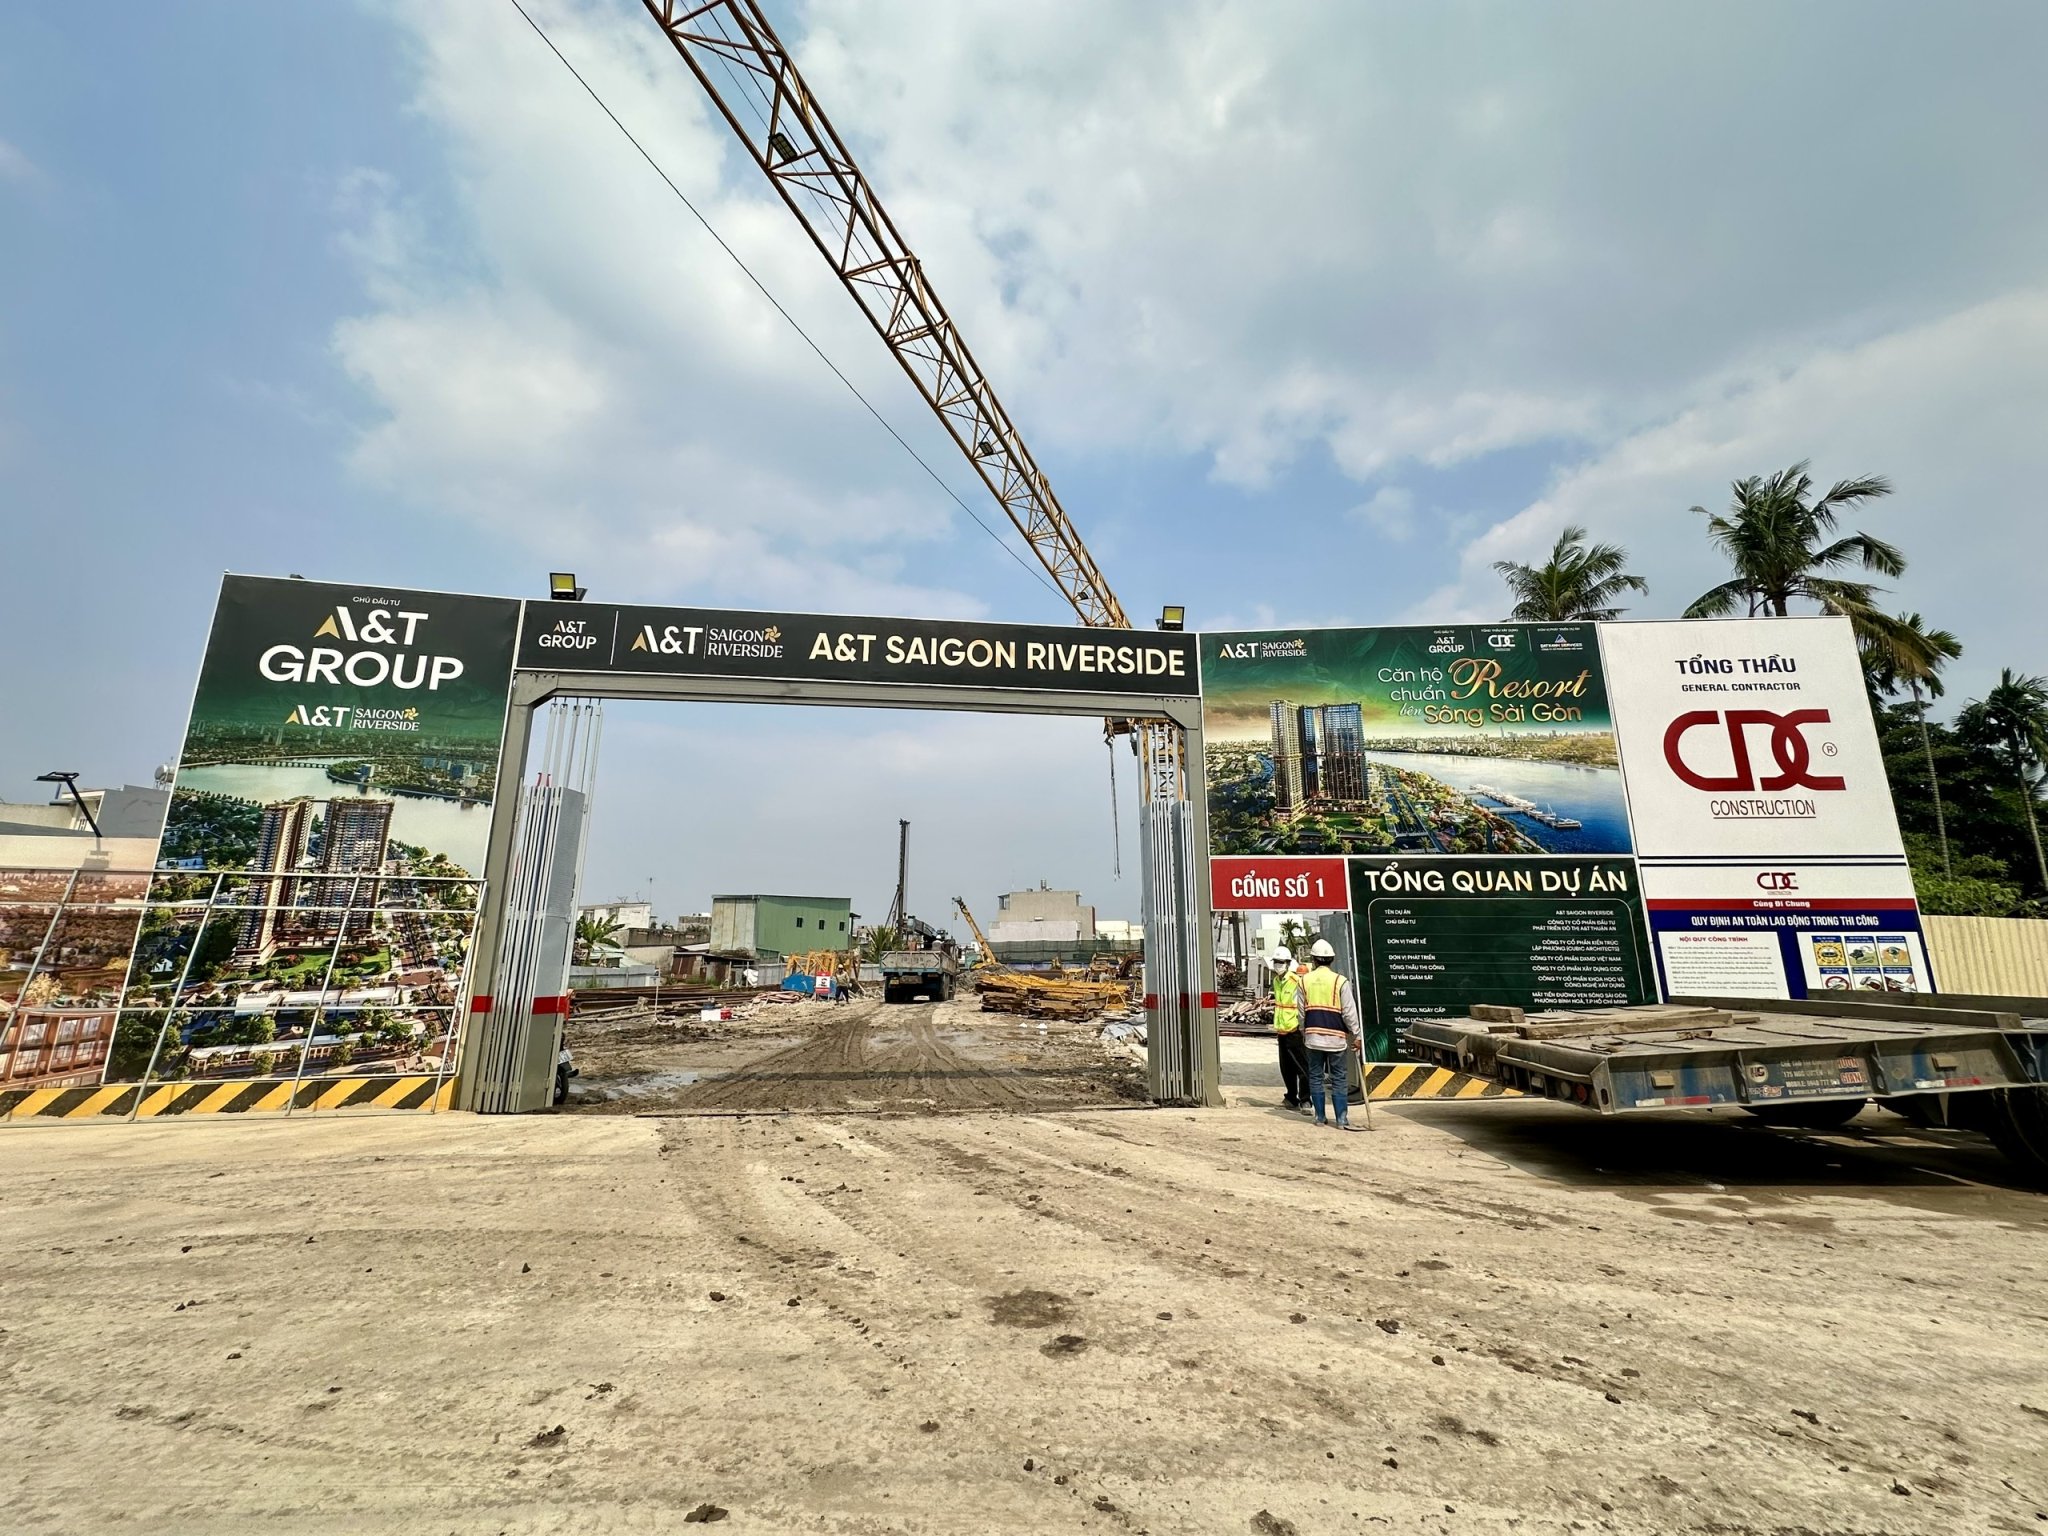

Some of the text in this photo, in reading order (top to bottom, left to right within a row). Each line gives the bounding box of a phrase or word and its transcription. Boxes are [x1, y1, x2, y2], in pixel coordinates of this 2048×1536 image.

[314, 606, 428, 645] A&T
[553, 620, 586, 634] A&T
[538, 634, 596, 650] GROUP
[631, 625, 764, 654] A&T SAIGON
[708, 643, 783, 658] RIVERSIDE
[808, 632, 1185, 676] A&T SAIGON RIVERSIDE
[1220, 642, 1295, 658] A&T SAIGON
[1262, 649, 1307, 658] RIVERSIDE
[1428, 644, 1464, 654] GROUP
[259, 645, 464, 690] GROUP
[1675, 654, 1796, 674] TỔNG THẦU
[1378, 658, 1592, 699] Căn hộ Resort
[1682, 682, 1800, 692] GENERAL CONTRACTOR
[1390, 684, 1446, 701] chuẩn
[285, 704, 404, 727] A&T SAIGON
[1424, 704, 1484, 727] Sông
[1490, 703, 1524, 722] Sài
[1532, 702, 1582, 722] Gòn
[353, 718, 420, 731] RIVERSIDE
[1664, 709, 1846, 792] CDC
[1710, 800, 1816, 816] CONSTRUCTION
[1231, 870, 1324, 898] CỔNG SỐ 1
[1364, 862, 1628, 897] TỔNG QUAN DỰ ÁN
[1757, 872, 1799, 890] CDC
[1691, 915, 1879, 927] QUY ĐỊNH AN TOÀN LAO ĐỘNG TRONG THI CÔNG
